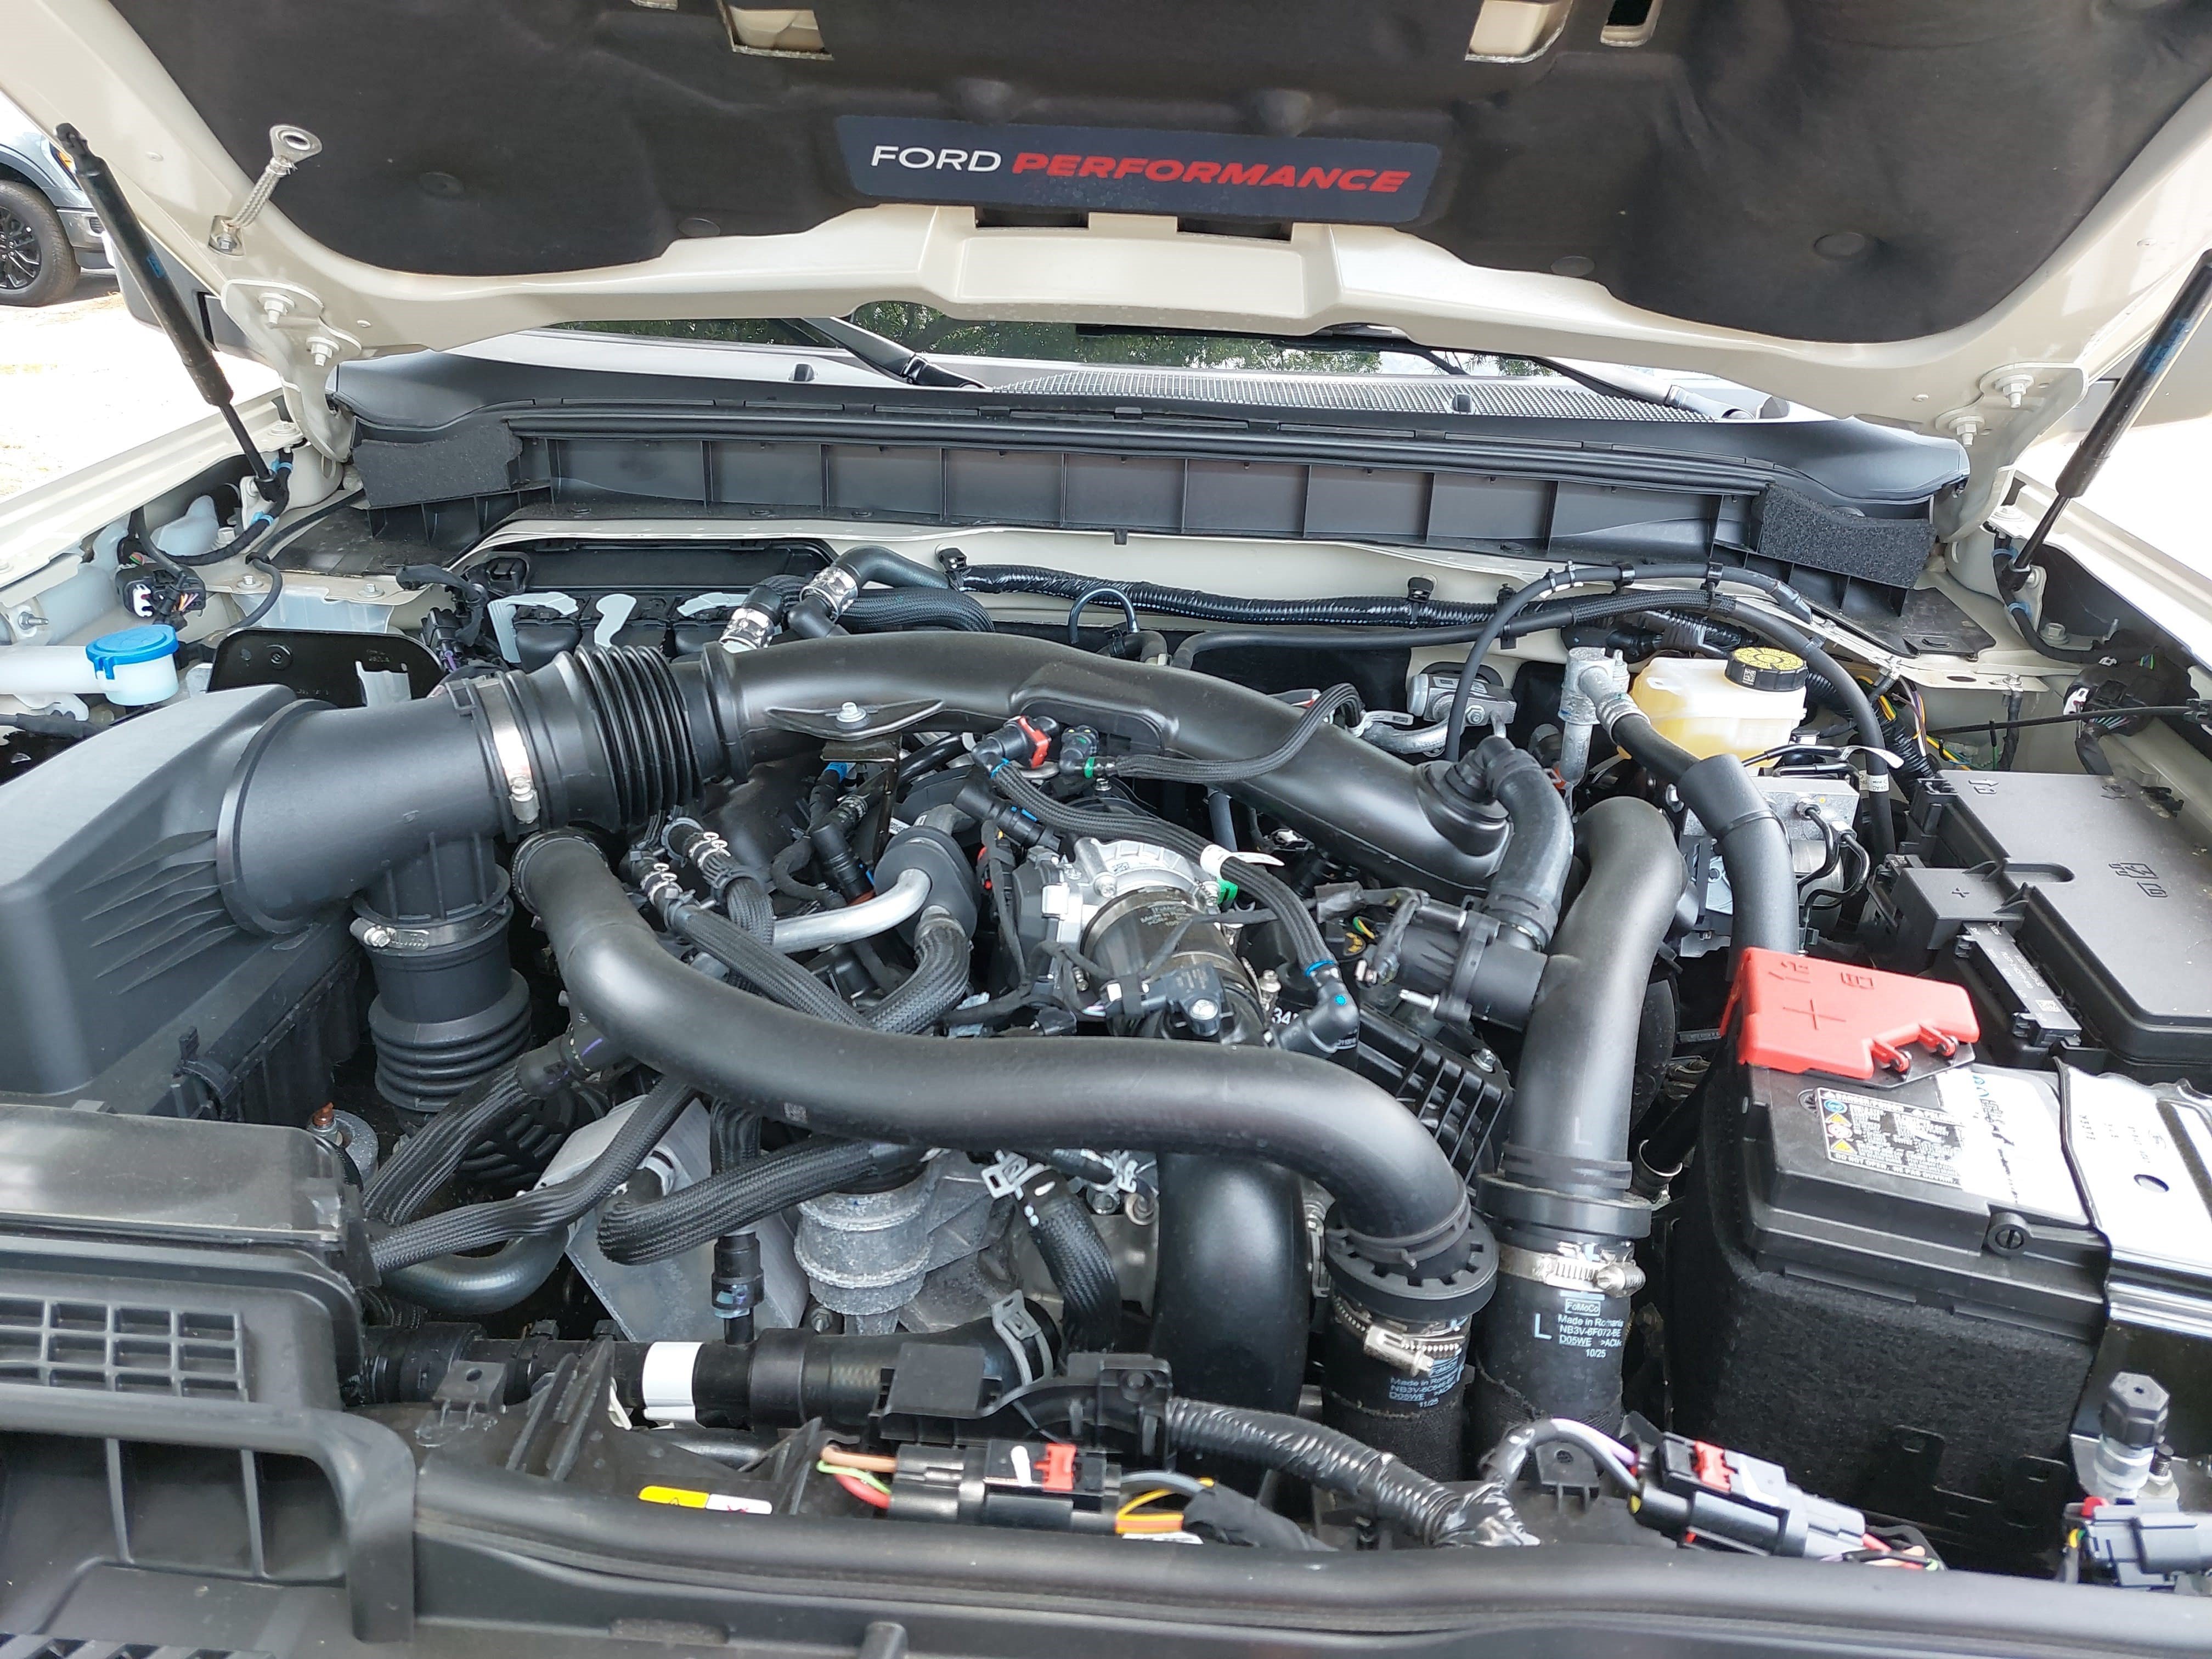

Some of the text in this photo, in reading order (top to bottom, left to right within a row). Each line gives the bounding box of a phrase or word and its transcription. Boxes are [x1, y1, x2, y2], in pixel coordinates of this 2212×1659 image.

[871, 145, 1411, 192] FORD PERFORMANCE
[1272, 1007, 1299, 1025] 34
[1567, 1301, 1599, 1313] FoMoCo
[1534, 1313, 1552, 1340] L
[1558, 1313, 1584, 1325] Made
[1585, 1318, 1594, 1327] in
[1559, 1334, 1592, 1346] D05WE
[1586, 1348, 1606, 1358] 10/25
[1390, 1378, 1419, 1386] Made
[1421, 1378, 1429, 1386] in
